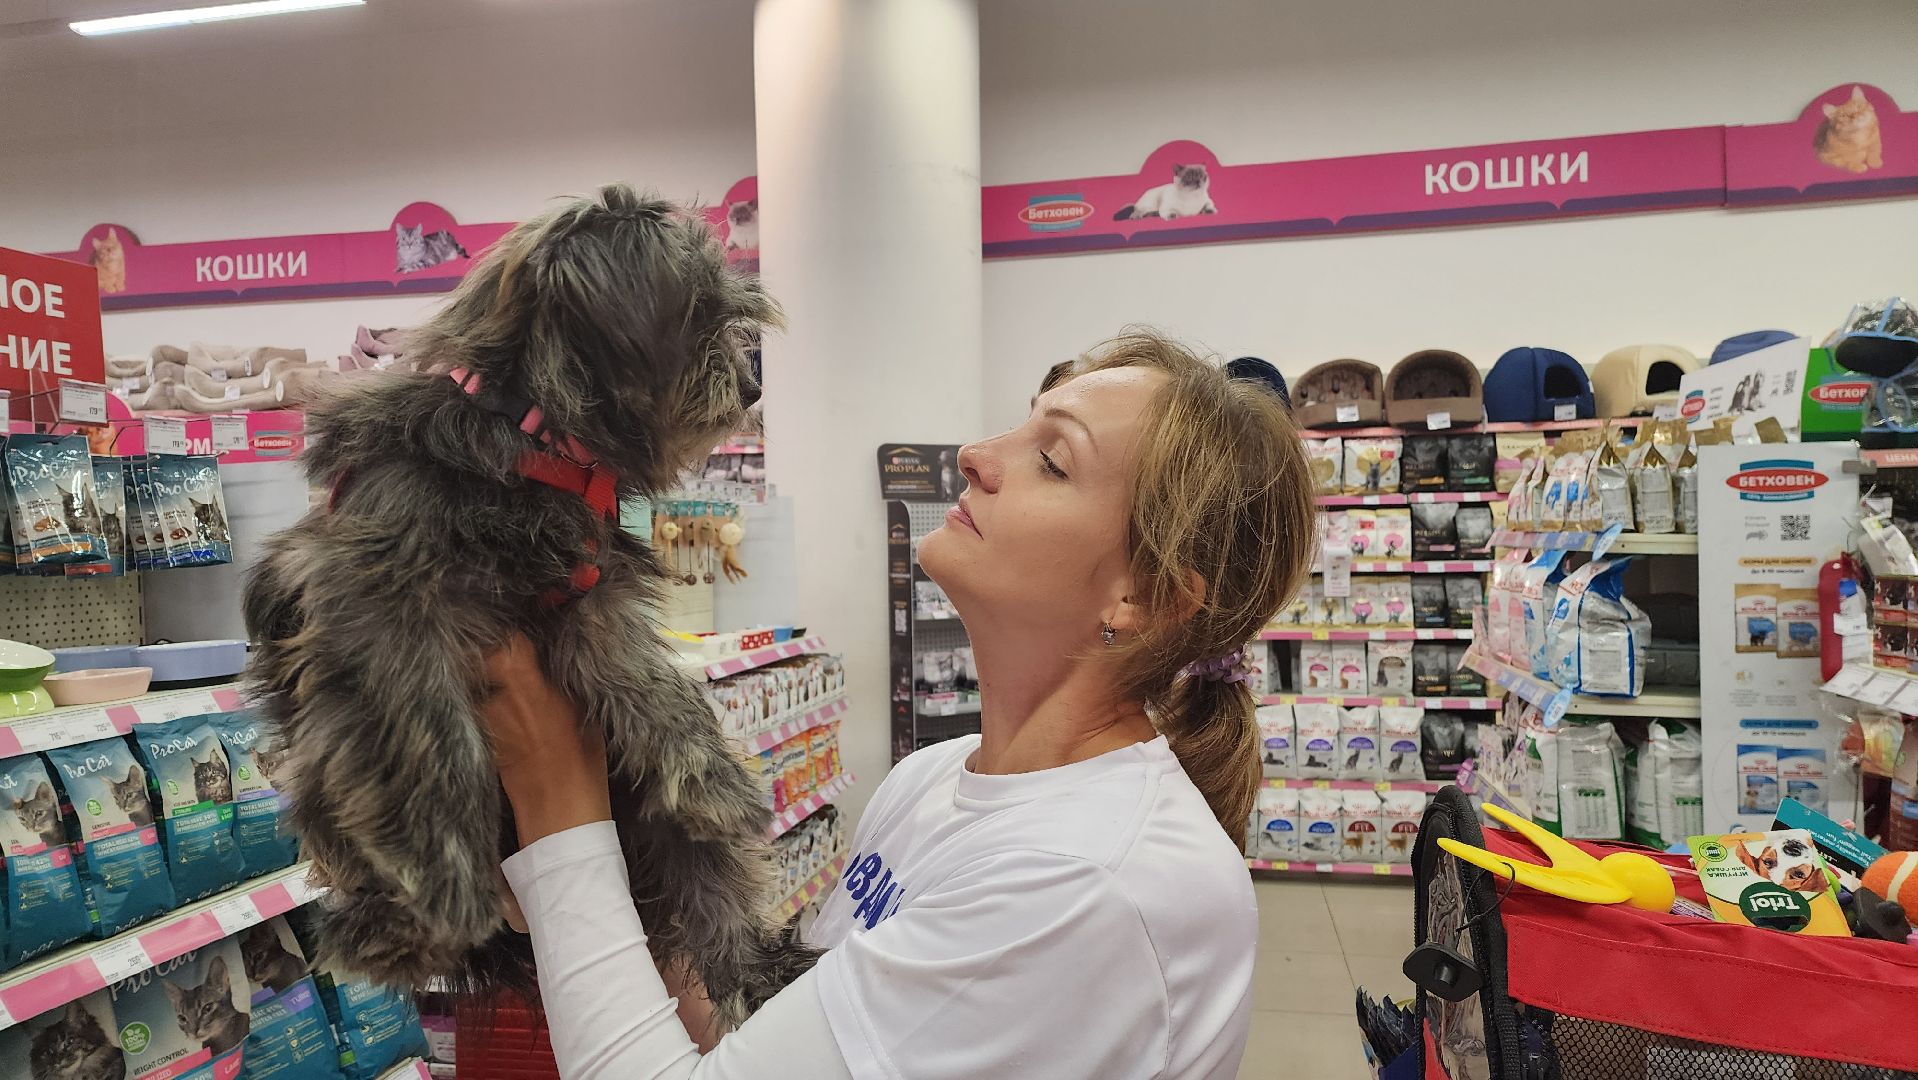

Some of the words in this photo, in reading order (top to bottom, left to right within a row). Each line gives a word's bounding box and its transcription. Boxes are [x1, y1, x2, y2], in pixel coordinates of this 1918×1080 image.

[1425, 151, 1588, 195] КОШКИ
[1028, 206, 1083, 219] Бетховен
[196, 251, 308, 282] КОШКИ
[1739, 475, 1815, 487] БЕТХОВЕН
[1750, 893, 1800, 911] Triol
[157, 1047, 190, 1066] CONTROL
